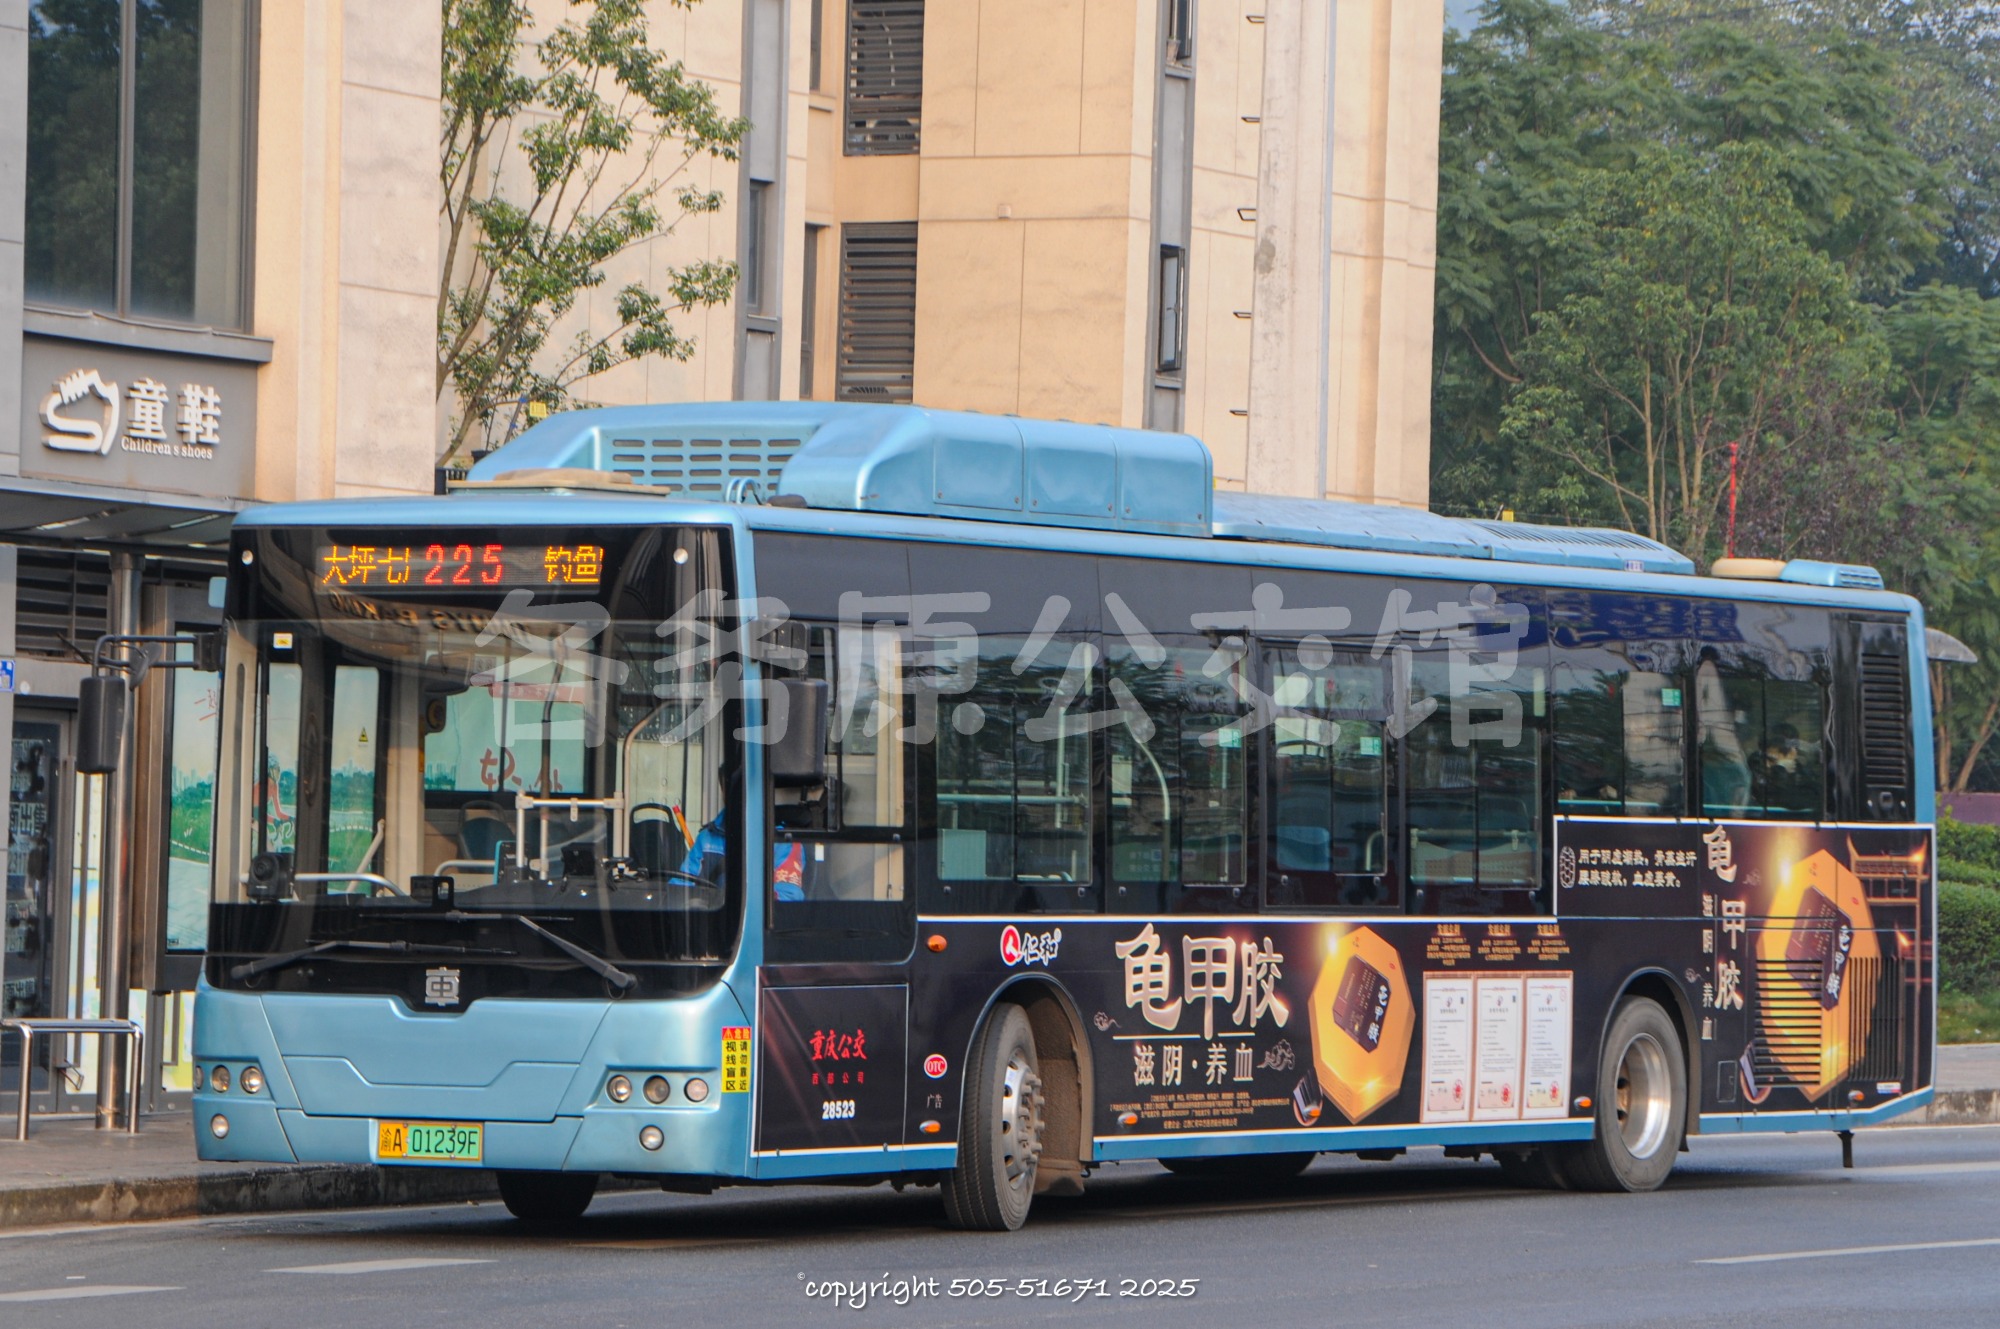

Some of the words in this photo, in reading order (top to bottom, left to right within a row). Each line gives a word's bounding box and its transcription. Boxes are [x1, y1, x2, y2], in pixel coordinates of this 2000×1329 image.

[127, 377, 222, 444] 童鞋
[181, 443, 213, 459] shoes
[322, 545, 410, 584] 大坪七
[425, 544, 503, 585] 225
[544, 545, 604, 584] 钓鱼
[1703, 825, 1746, 1010] 龟甲胶
[1115, 922, 1290, 1040] 龟甲胶
[809, 1029, 867, 1061] 重庆公交
[725, 1041, 737, 1091] 视线盲区
[739, 1041, 748, 1091] 请勿靠近
[926, 1060, 945, 1073] OTC
[822, 1099, 856, 1120] 28523
[926, 1093, 943, 1109] 广告
